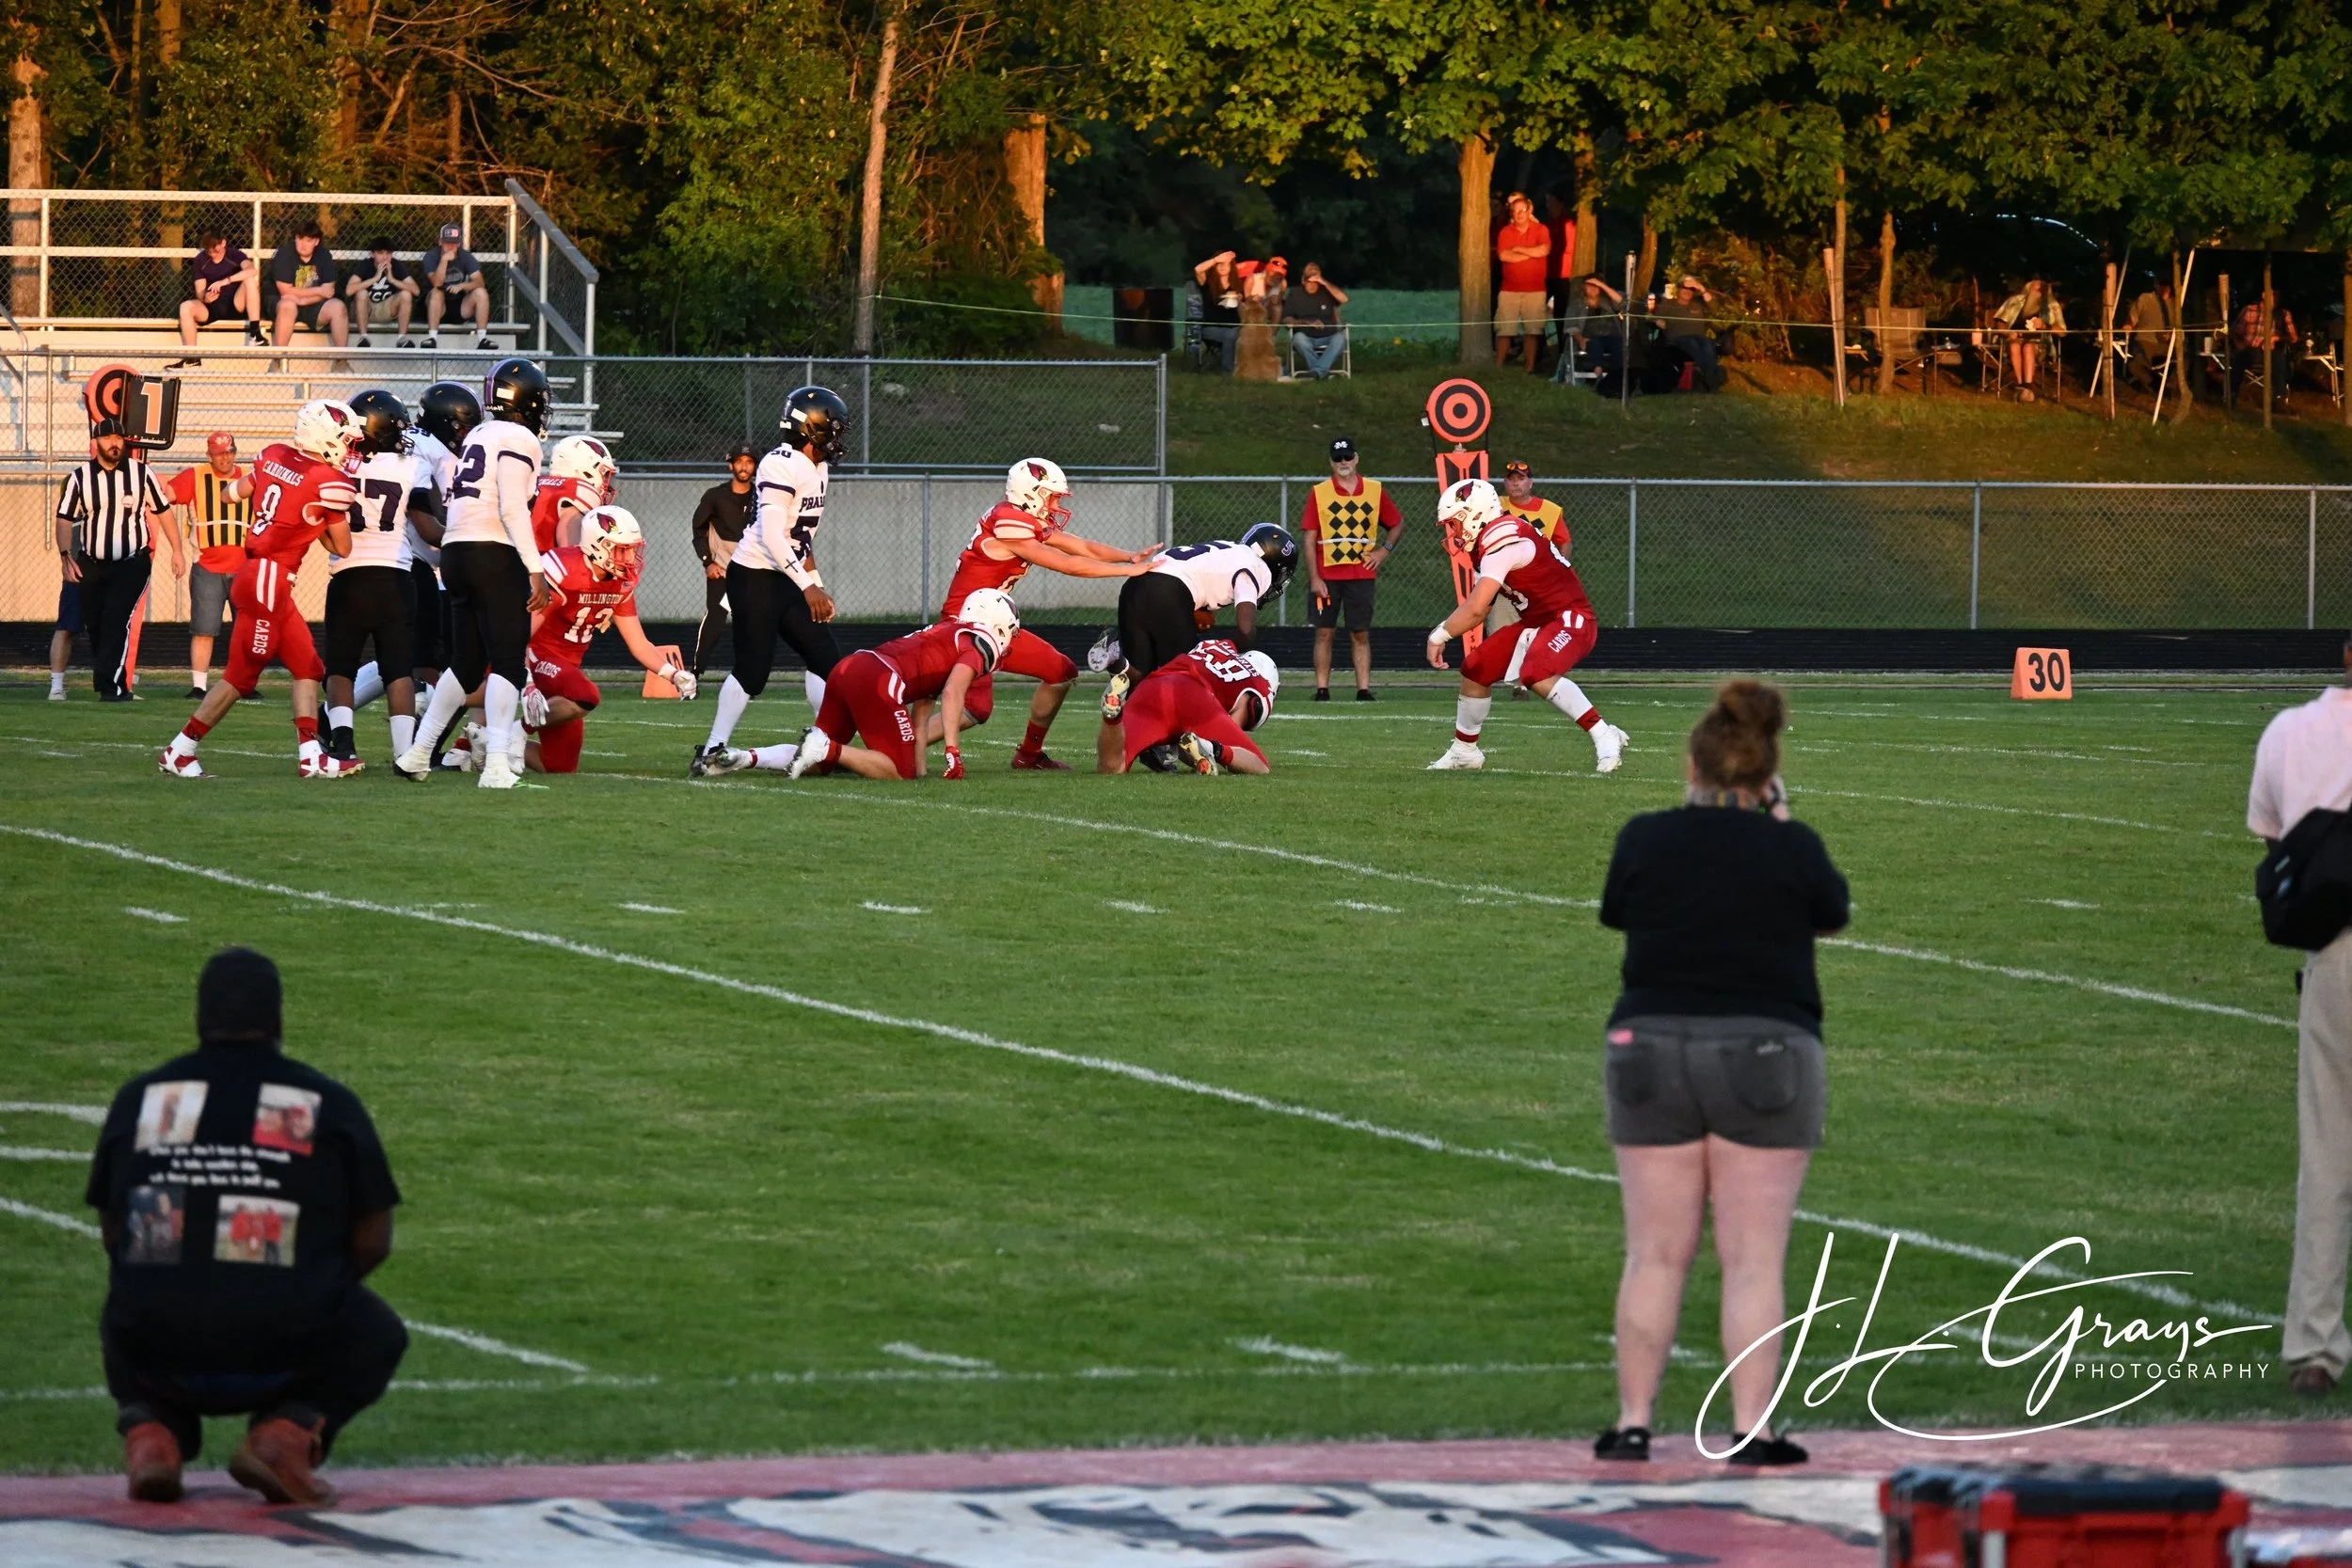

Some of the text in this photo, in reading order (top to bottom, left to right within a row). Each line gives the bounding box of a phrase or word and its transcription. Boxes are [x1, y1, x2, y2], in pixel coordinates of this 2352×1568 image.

[140, 381, 164, 435] 1
[262, 460, 305, 487] CARDINALS
[790, 515, 820, 562] 5
[1280, 539, 1295, 557] 5
[578, 593, 624, 605] MILLINGTON
[251, 618, 270, 656] CARDS
[1547, 629, 1573, 654] CARDS
[534, 660, 562, 679] CARDS
[2028, 652, 2065, 692] 30
[894, 709, 914, 743] CARDS
